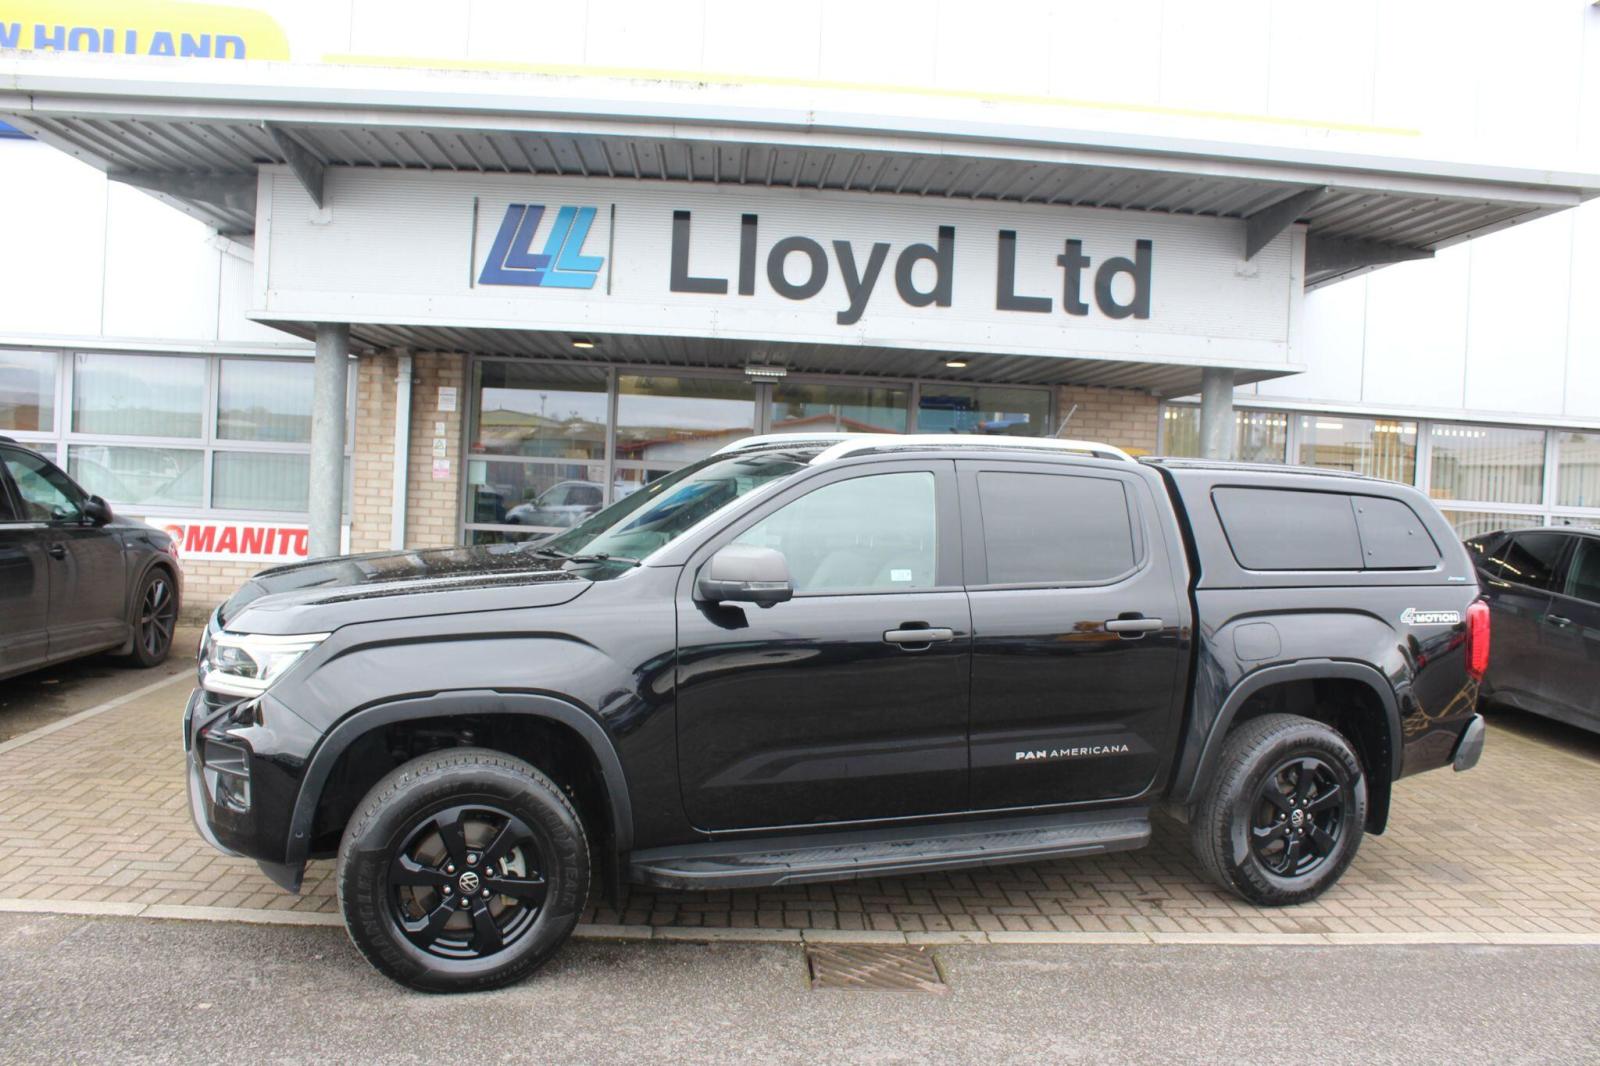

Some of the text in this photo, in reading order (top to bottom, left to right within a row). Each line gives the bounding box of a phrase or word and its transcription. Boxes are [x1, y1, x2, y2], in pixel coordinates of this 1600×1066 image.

[670, 210, 1152, 325] Lloyd Ltd
[1015, 744, 1129, 760] PAN AMERICANA
